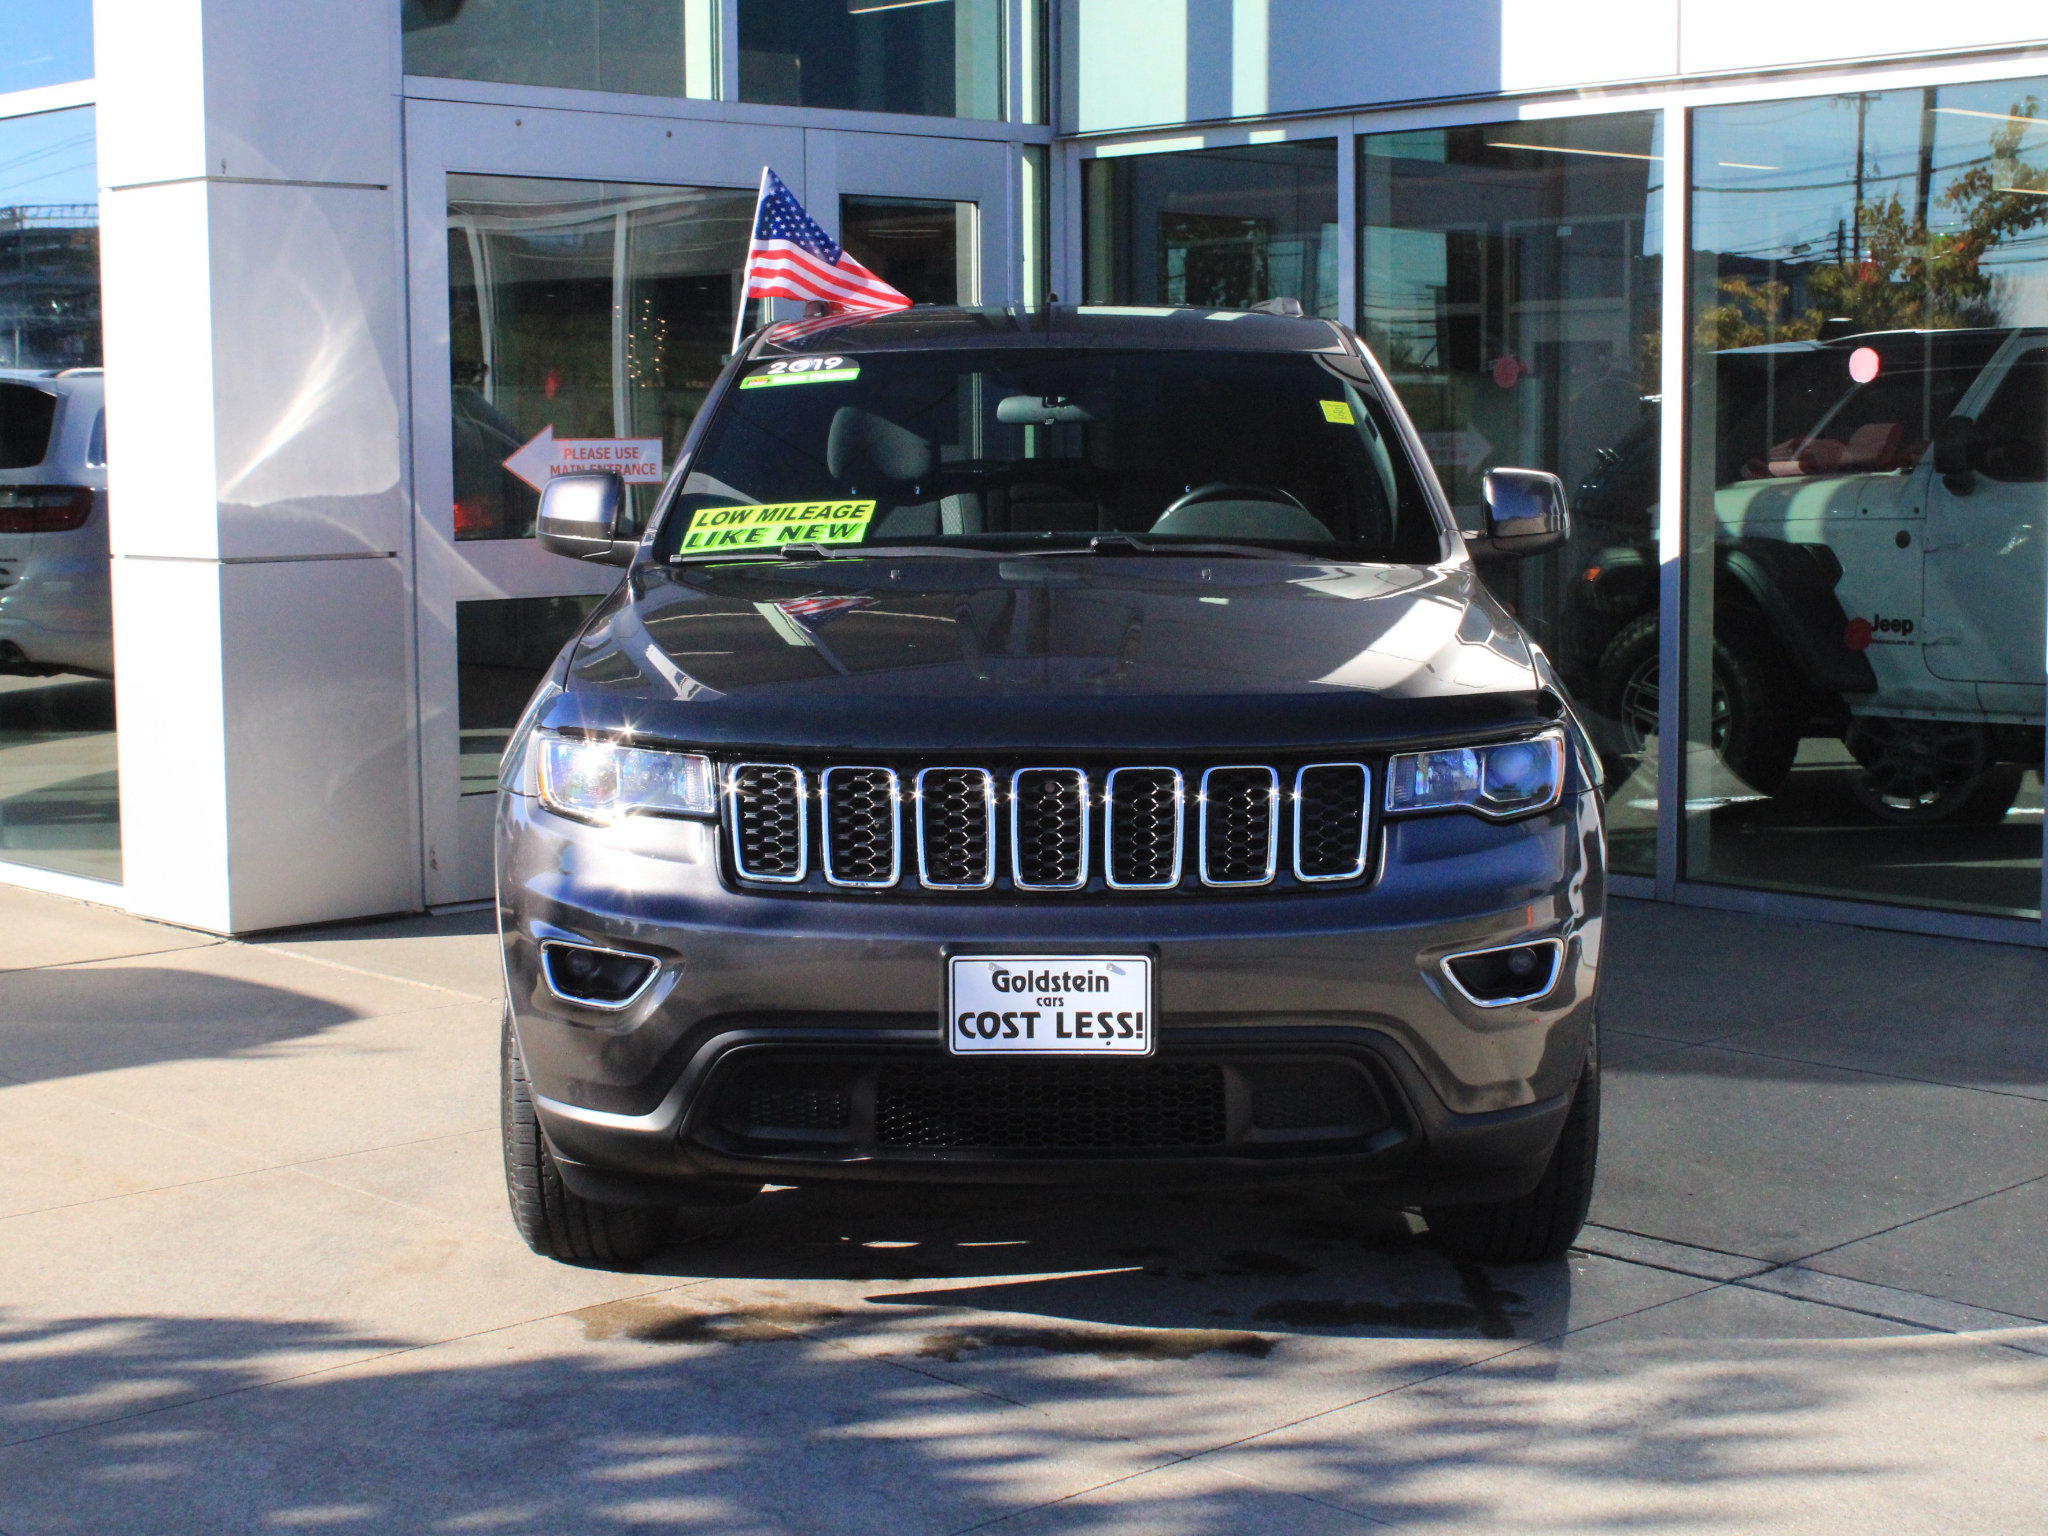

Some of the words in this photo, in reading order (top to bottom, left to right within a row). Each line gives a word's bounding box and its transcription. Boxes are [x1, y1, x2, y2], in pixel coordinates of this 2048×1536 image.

[767, 356, 844, 374] 2019
[564, 447, 611, 461] PLEASE
[615, 447, 639, 459] USE
[550, 465, 585, 478] MAIN
[695, 508, 754, 527] LOW
[755, 504, 870, 522] MILEAGE
[685, 527, 769, 548] LIKE
[776, 522, 863, 541] NEW
[1871, 613, 1914, 636] Jeep
[991, 969, 1110, 993] Goldstein
[1036, 996, 1065, 1007] cars
[957, 1011, 1041, 1039] COST
[1056, 1011, 1144, 1039] LESS!
